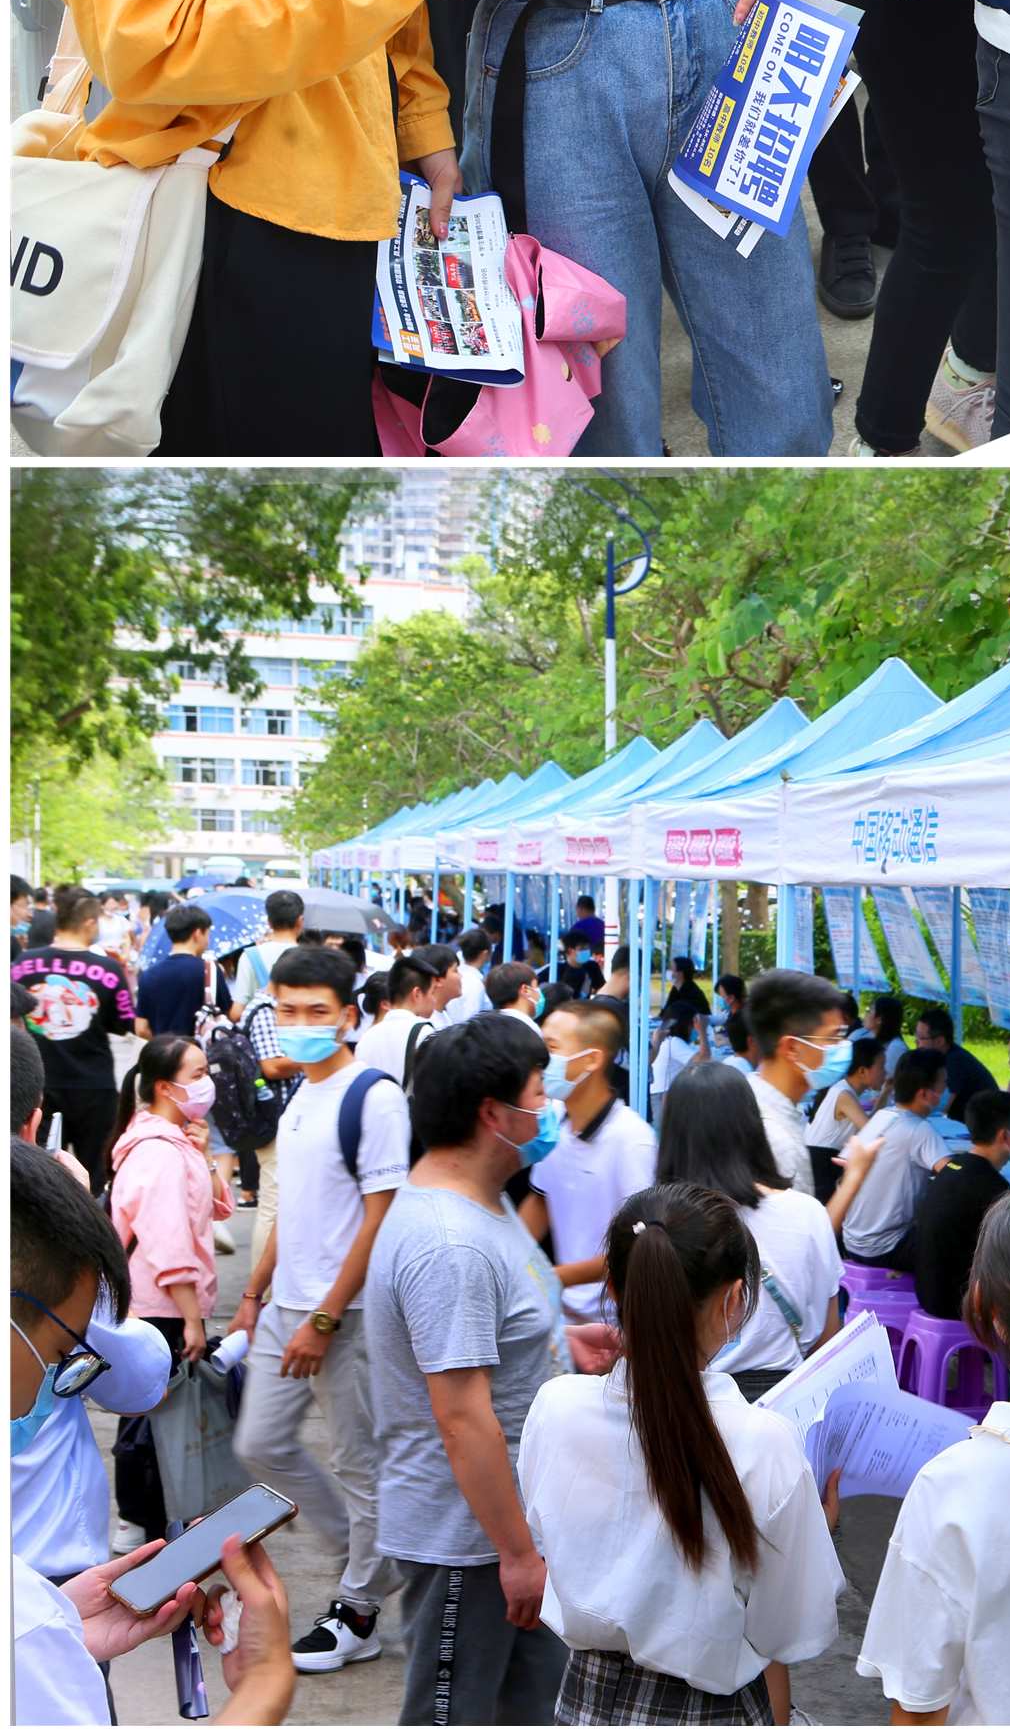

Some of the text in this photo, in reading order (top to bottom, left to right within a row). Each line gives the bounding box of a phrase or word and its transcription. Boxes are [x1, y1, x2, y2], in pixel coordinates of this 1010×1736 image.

[769, 11, 794, 57] COME
[761, 59, 778, 84] ON
[739, 23, 830, 208] 明大招聘
[851, 805, 939, 866] 中国移动通信
